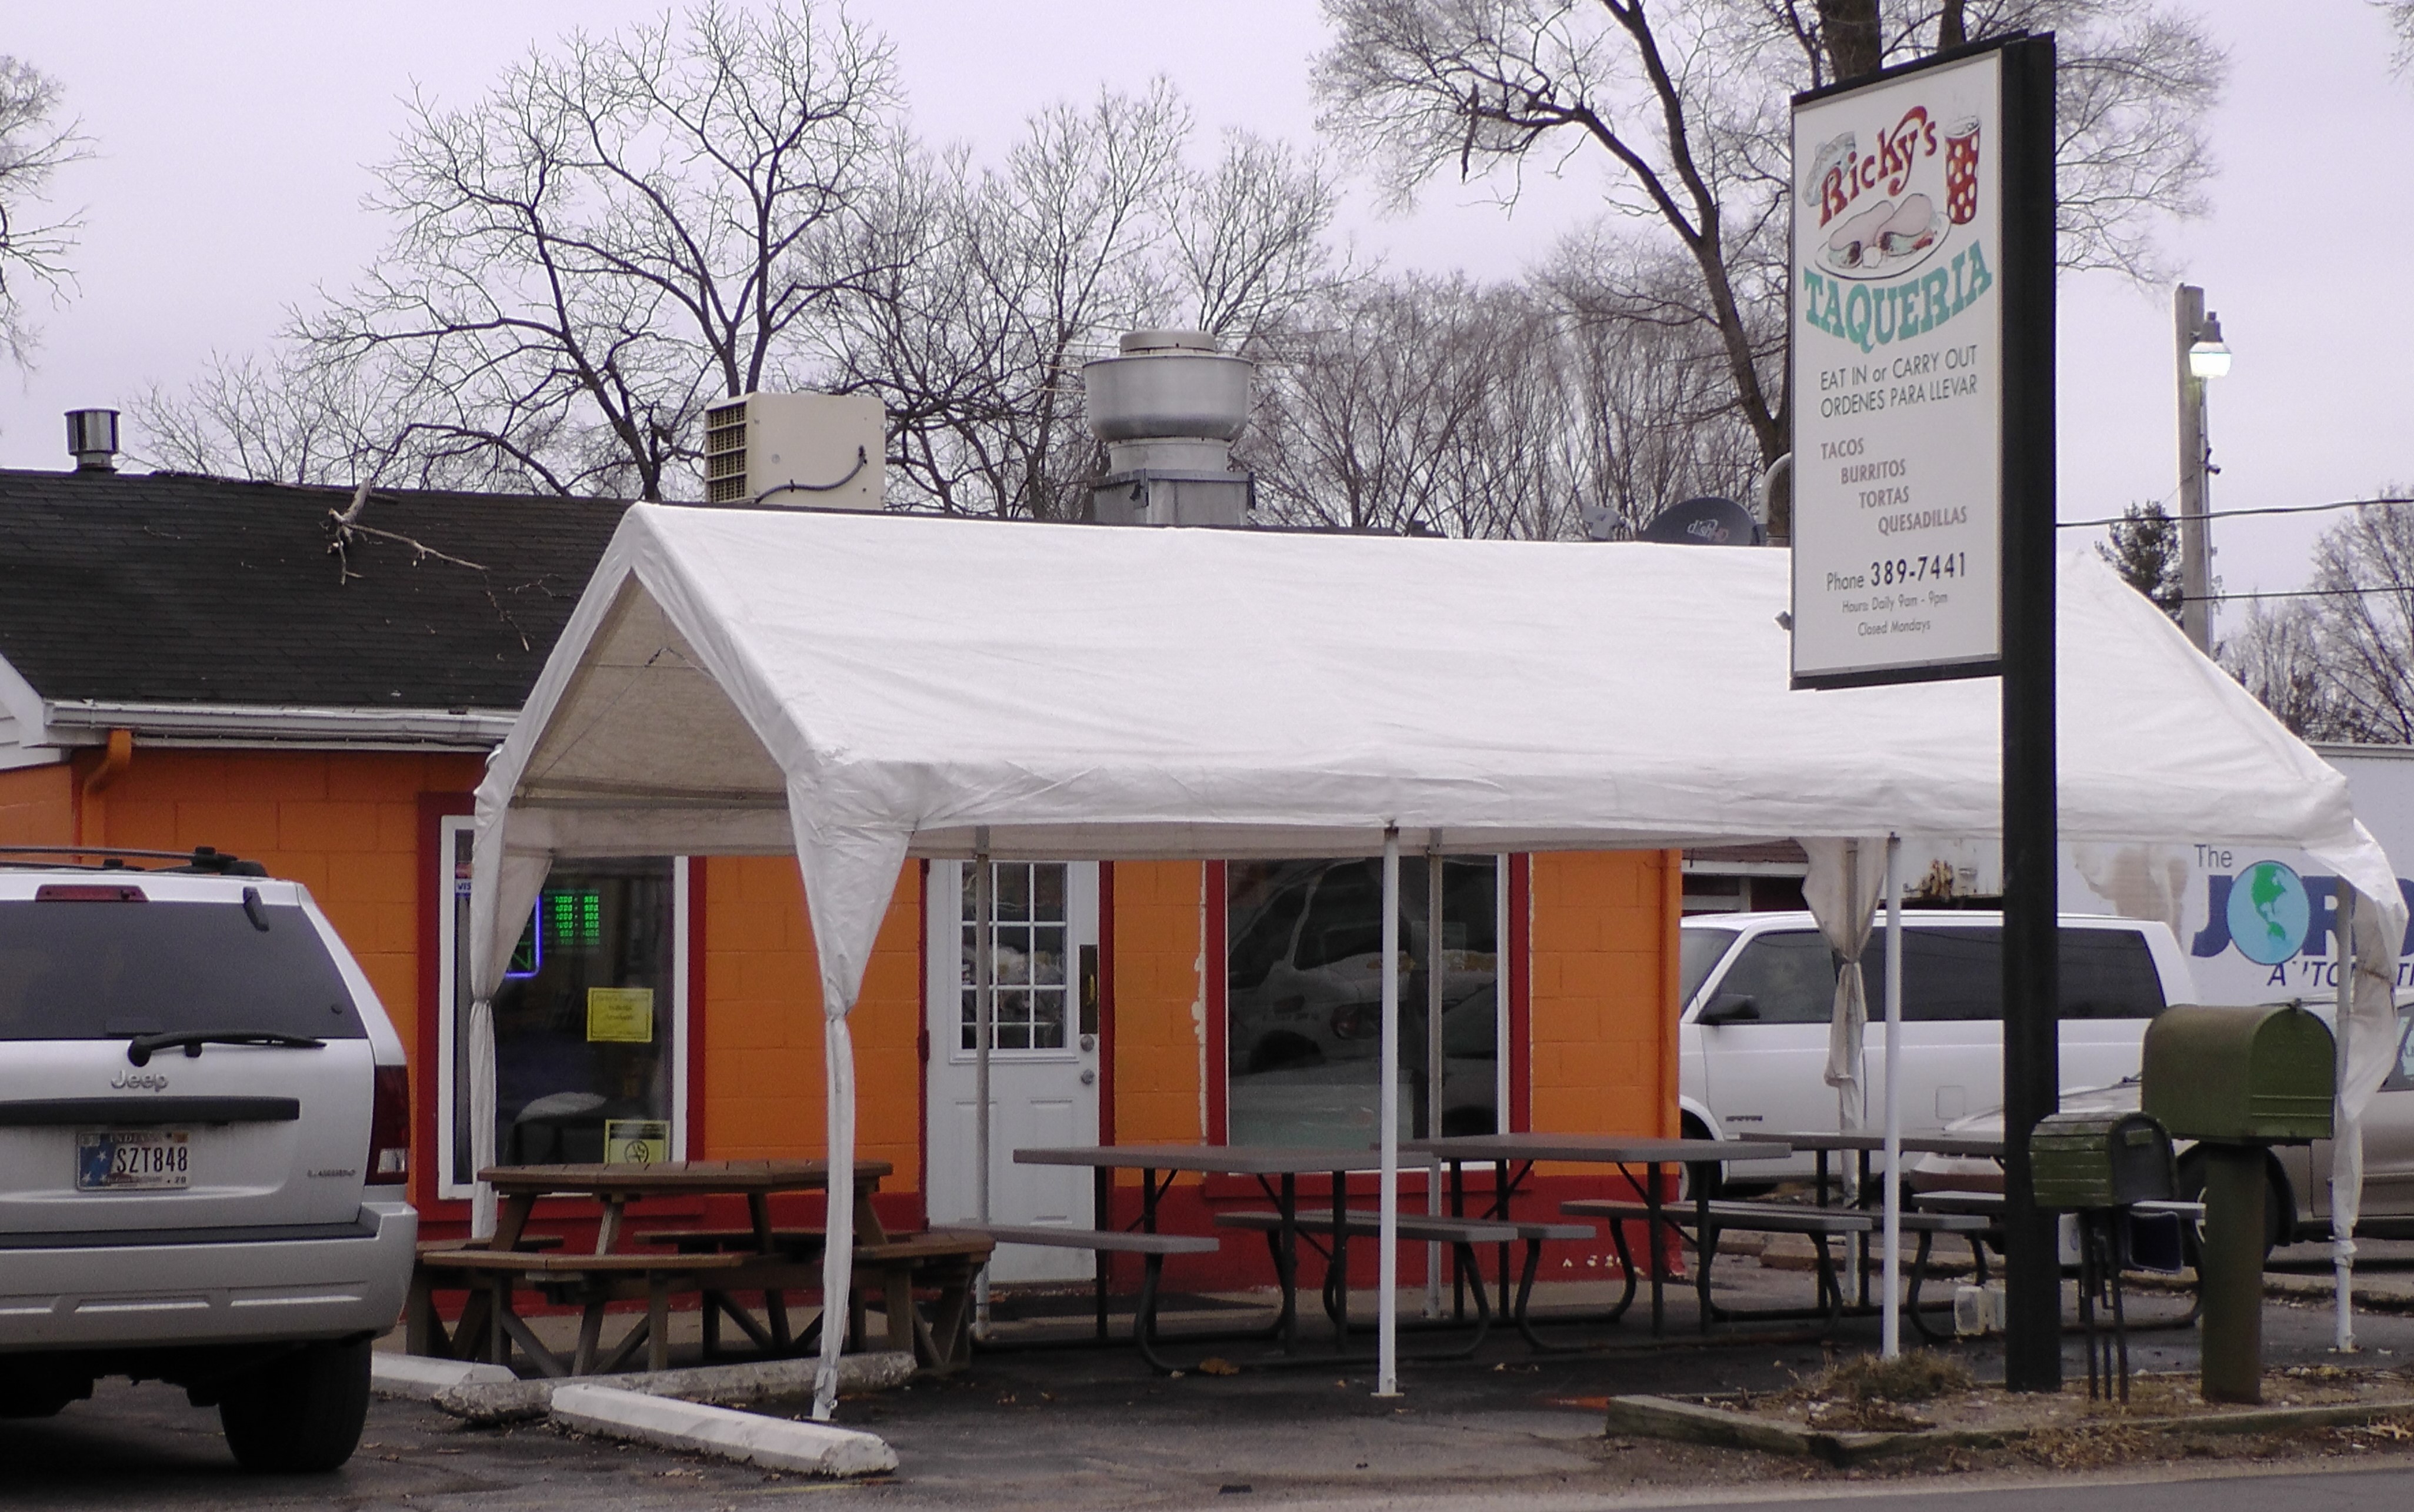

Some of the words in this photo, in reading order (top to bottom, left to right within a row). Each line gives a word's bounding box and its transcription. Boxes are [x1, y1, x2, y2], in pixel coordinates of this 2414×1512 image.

[1819, 106, 1937, 229] Ricky's
[1803, 239, 1992, 353] TAQUERIA
[1820, 368, 1846, 390] EAT
[1852, 365, 1867, 385] IN
[1873, 367, 1887, 382] or
[1893, 352, 1939, 379] CARRY
[1945, 345, 1977, 369] OUT
[1820, 389, 1885, 418] ORDENES
[1890, 384, 1925, 407] PARA
[1930, 374, 1978, 401] LLEVAR
[1820, 438, 1864, 460] TACOS
[1841, 458, 1906, 485] BURRITOS
[1859, 485, 1909, 508] TORTAS
[1878, 506, 1967, 536] QUESADILLAS
[1827, 571, 1865, 591] Phone
[1870, 552, 1965, 586] 389-7441
[1872, 596, 1895, 612] Daily
[1898, 593, 1918, 608] 9am
[1928, 590, 1948, 608] 9pm
[1858, 621, 1887, 636] Closed
[1890, 618, 1931, 633] Mondays
[2194, 845, 2232, 867] The
[111, 1070, 169, 1092] Jeep
[117, 1146, 188, 1173] SZT848
